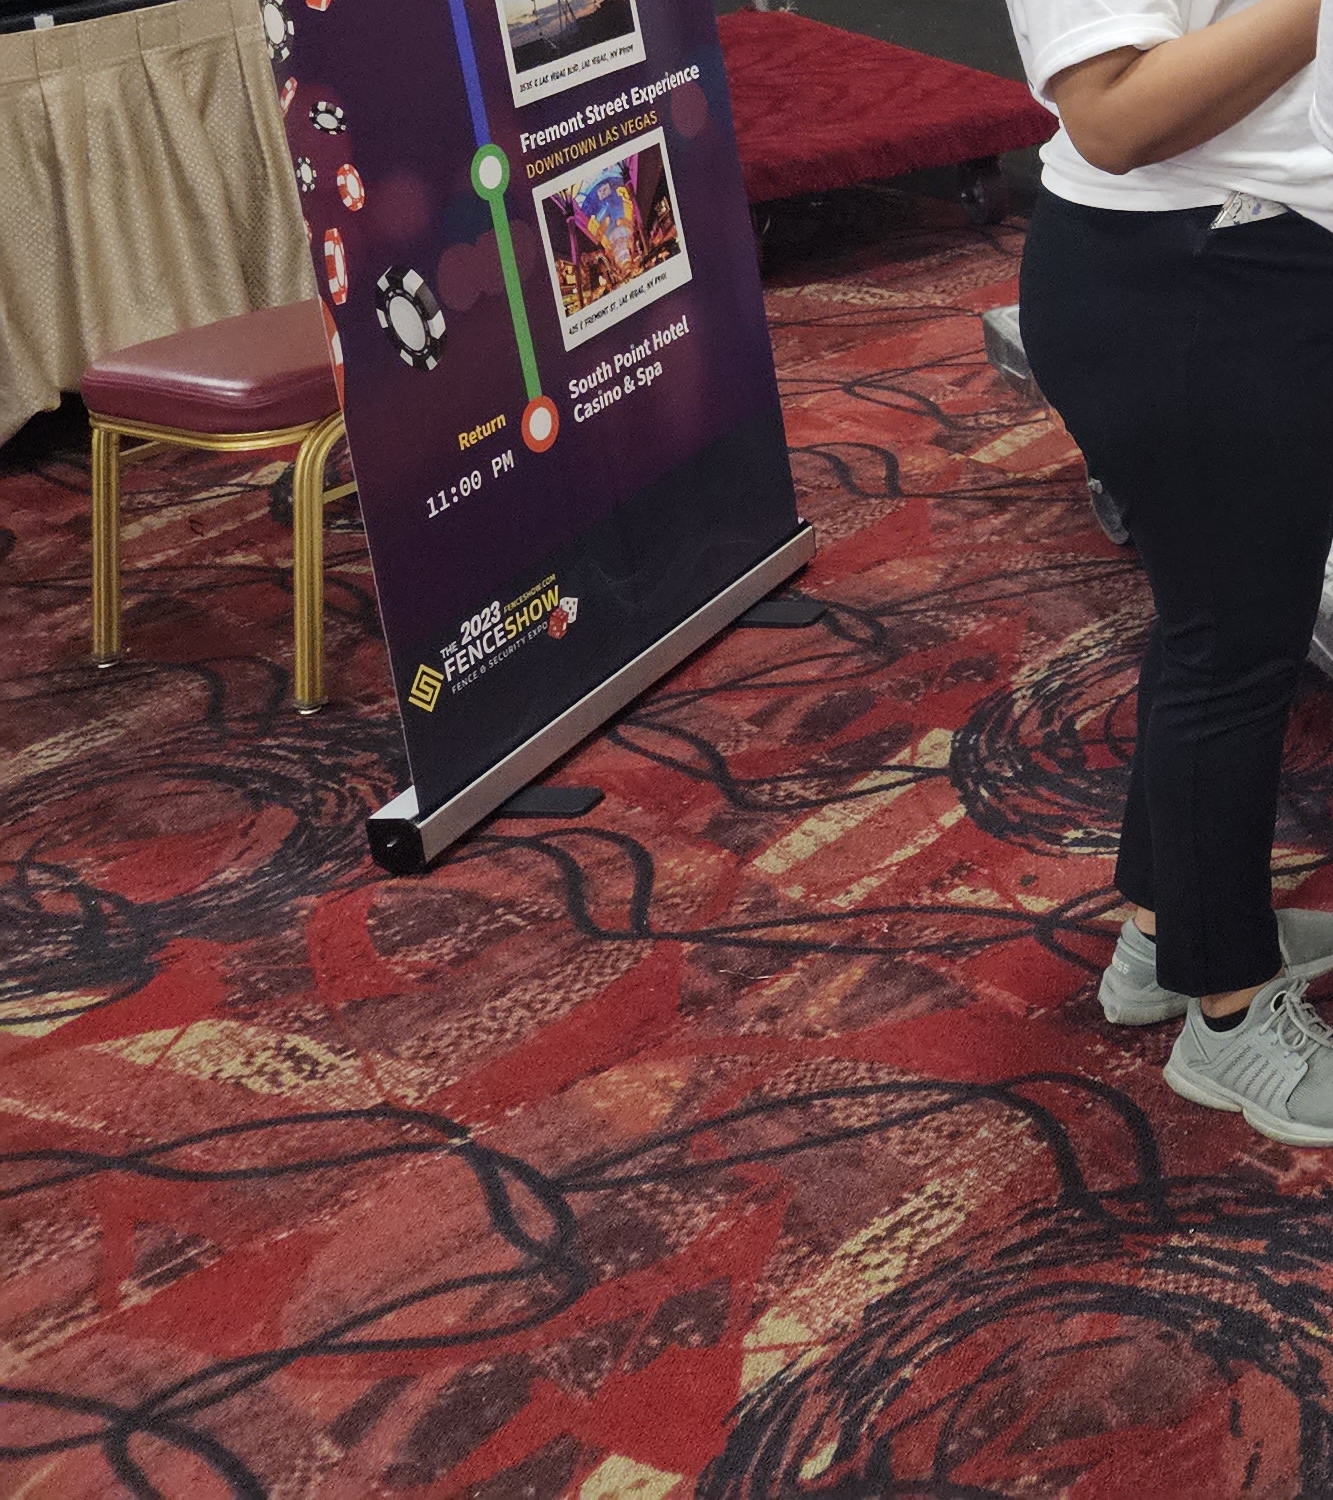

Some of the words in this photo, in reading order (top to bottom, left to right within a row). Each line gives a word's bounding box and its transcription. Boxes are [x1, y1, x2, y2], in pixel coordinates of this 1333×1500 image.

[520, 111, 585, 154] Fremont
[585, 92, 630, 125] Street
[630, 64, 700, 108] Experience
[526, 136, 597, 179] DOWNTOWN
[599, 128, 620, 147] LAS
[622, 110, 659, 138] VEGAS
[568, 362, 613, 399] South
[613, 338, 652, 374] Point
[651, 315, 690, 351] Hotel
[573, 385, 622, 423] Casino
[623, 375, 636, 394] &
[636, 361, 663, 387] Spa
[458, 414, 507, 451] Return
[426, 470, 482, 519] 11:00
[491, 449, 515, 479] PM
[440, 641, 459, 659] THE
[460, 601, 501, 646] 2023
[503, 573, 556, 615] FENCESHOW.COM
[444, 584, 559, 682] FENCESHOW
[451, 670, 479, 695] FENCE
[488, 636, 526, 669] SECURITY
[527, 620, 548, 642] EXPO
